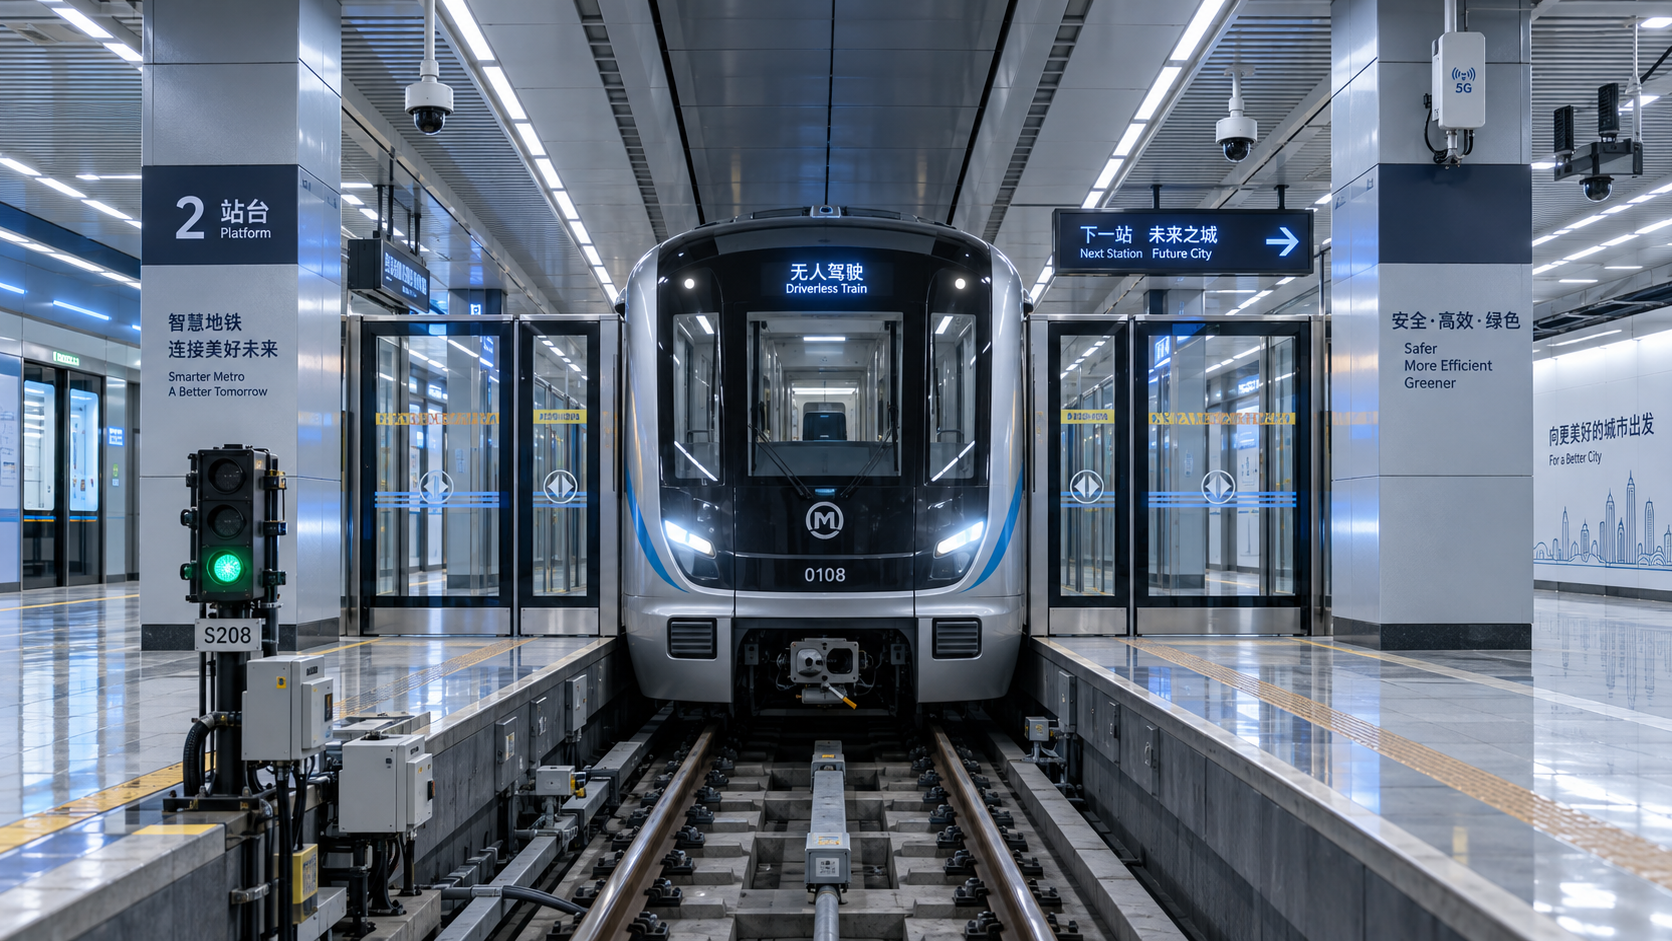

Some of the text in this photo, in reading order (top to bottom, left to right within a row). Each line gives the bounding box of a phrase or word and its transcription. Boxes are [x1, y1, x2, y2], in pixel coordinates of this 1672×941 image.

[1455, 83, 1472, 93] 5G
[175, 195, 205, 240] 2
[220, 199, 269, 224] 站台
[220, 227, 271, 239] Platform
[1080, 225, 1218, 244] 下一站 未来之城
[1080, 248, 1212, 261] Next Station Future City
[791, 262, 863, 281] 无人驾驶
[786, 283, 867, 294] Driverless Train
[168, 312, 242, 332] 智慧地铁
[168, 339, 278, 359] 连接美好未来
[1404, 342, 1437, 355] Safer
[1404, 359, 1493, 371] More Efficient
[168, 371, 245, 382] Smarter Metro
[1404, 376, 1456, 389] Greener
[168, 386, 268, 397] A Better Tomorrow
[1549, 412, 1654, 446] 向更美好的城市出发
[1549, 450, 1602, 466] For a Better City
[814, 511, 836, 529] M
[804, 567, 846, 582] 0108
[204, 626, 252, 644] S208
